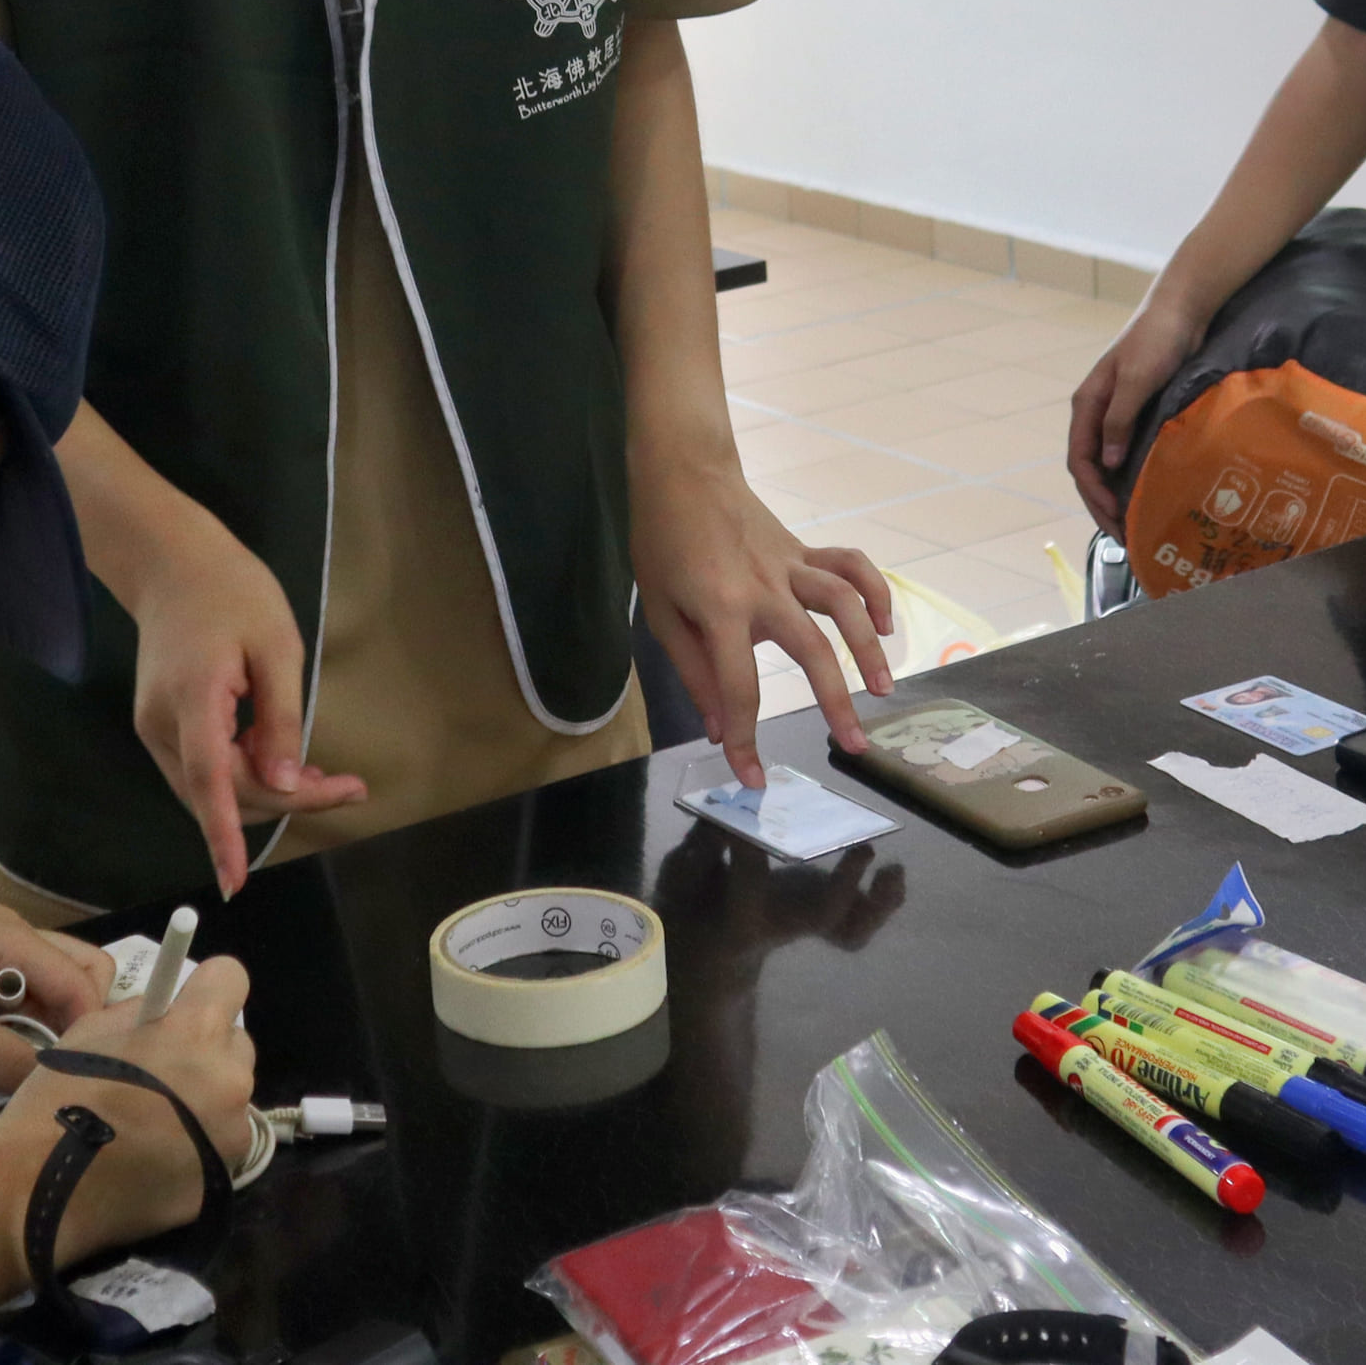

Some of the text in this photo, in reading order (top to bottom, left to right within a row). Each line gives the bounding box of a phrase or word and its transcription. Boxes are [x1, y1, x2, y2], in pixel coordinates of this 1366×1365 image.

[517, 84, 582, 121] Butterworth
[581, 79, 597, 96] Lay
[1114, 1036, 1176, 1074] PERFORMANCE
[1176, 1059, 1200, 1083] HIGH
[1136, 1058, 1211, 1111] Artline
[1121, 1097, 1156, 1127] DRY SAFE
[1183, 1134, 1217, 1162] PERMANENT
